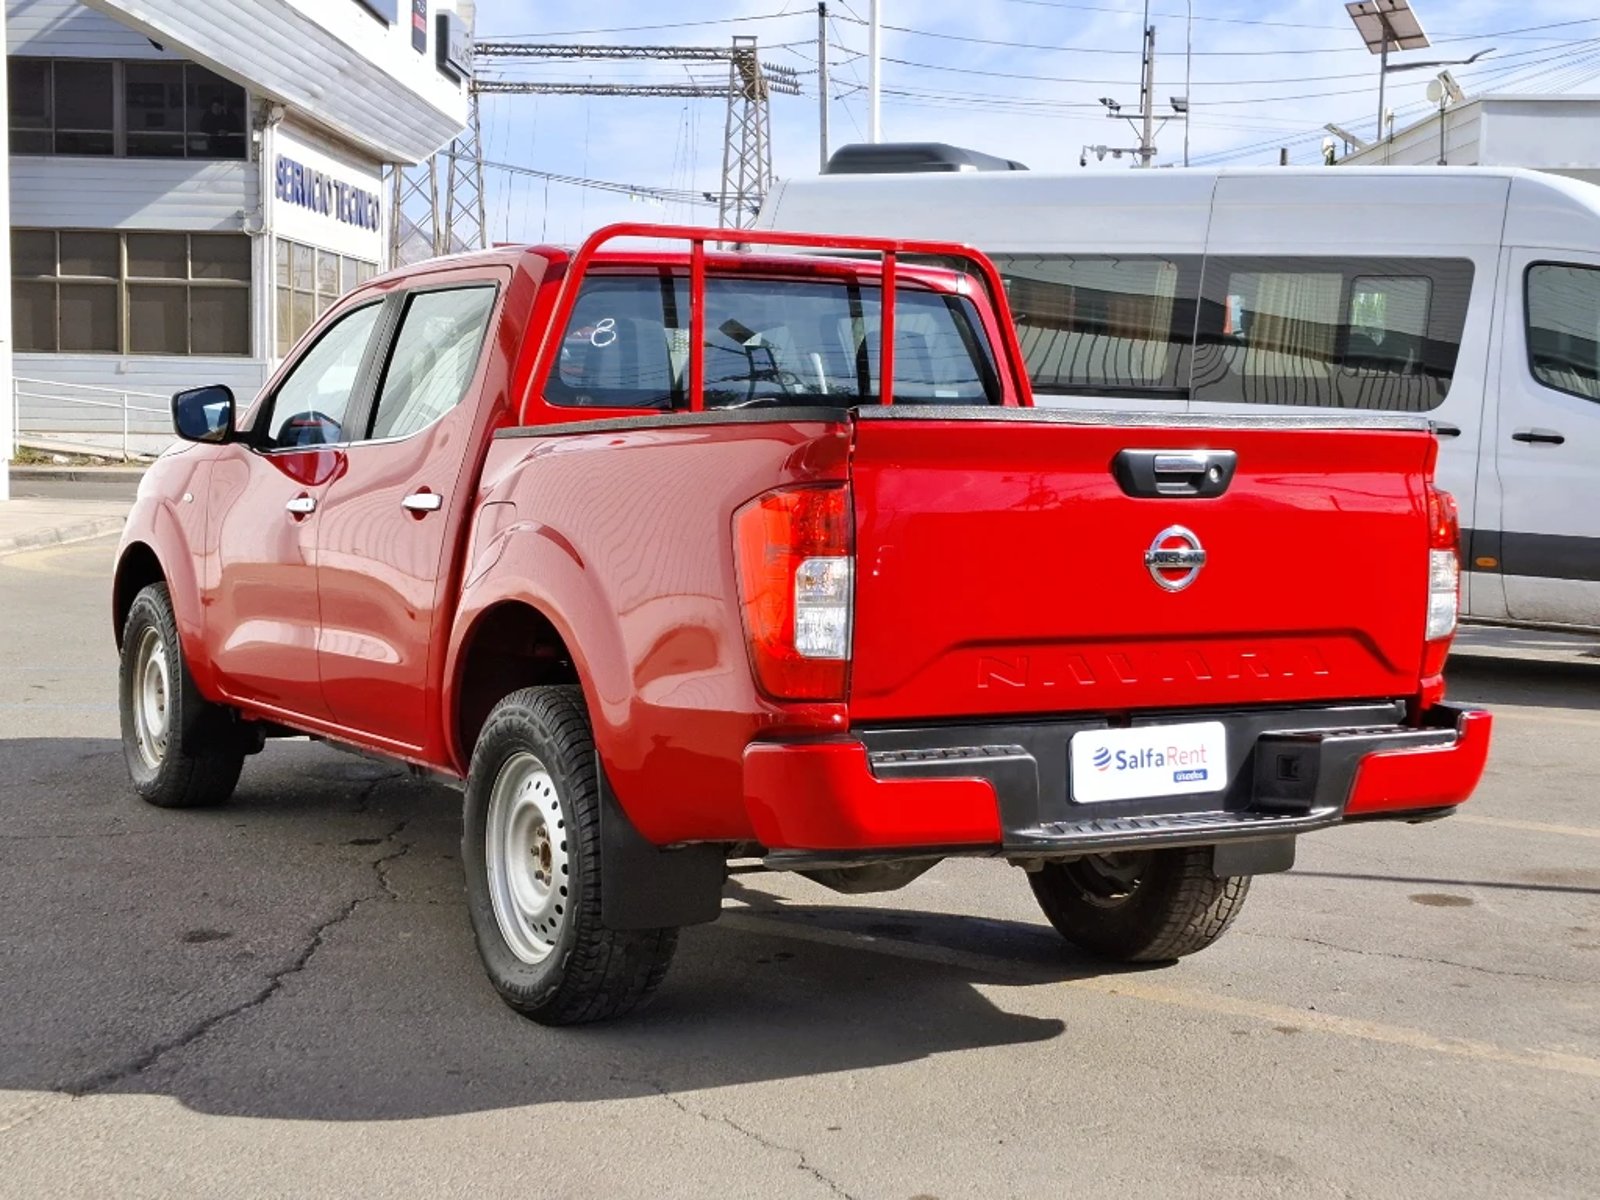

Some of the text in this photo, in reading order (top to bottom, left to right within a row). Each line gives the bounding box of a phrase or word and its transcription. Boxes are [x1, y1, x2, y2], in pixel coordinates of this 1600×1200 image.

[275, 153, 380, 233] SERVICIO TECNICO
[1153, 551, 1203, 565] NISSAN
[1115, 744, 1208, 770] SalfaRent
